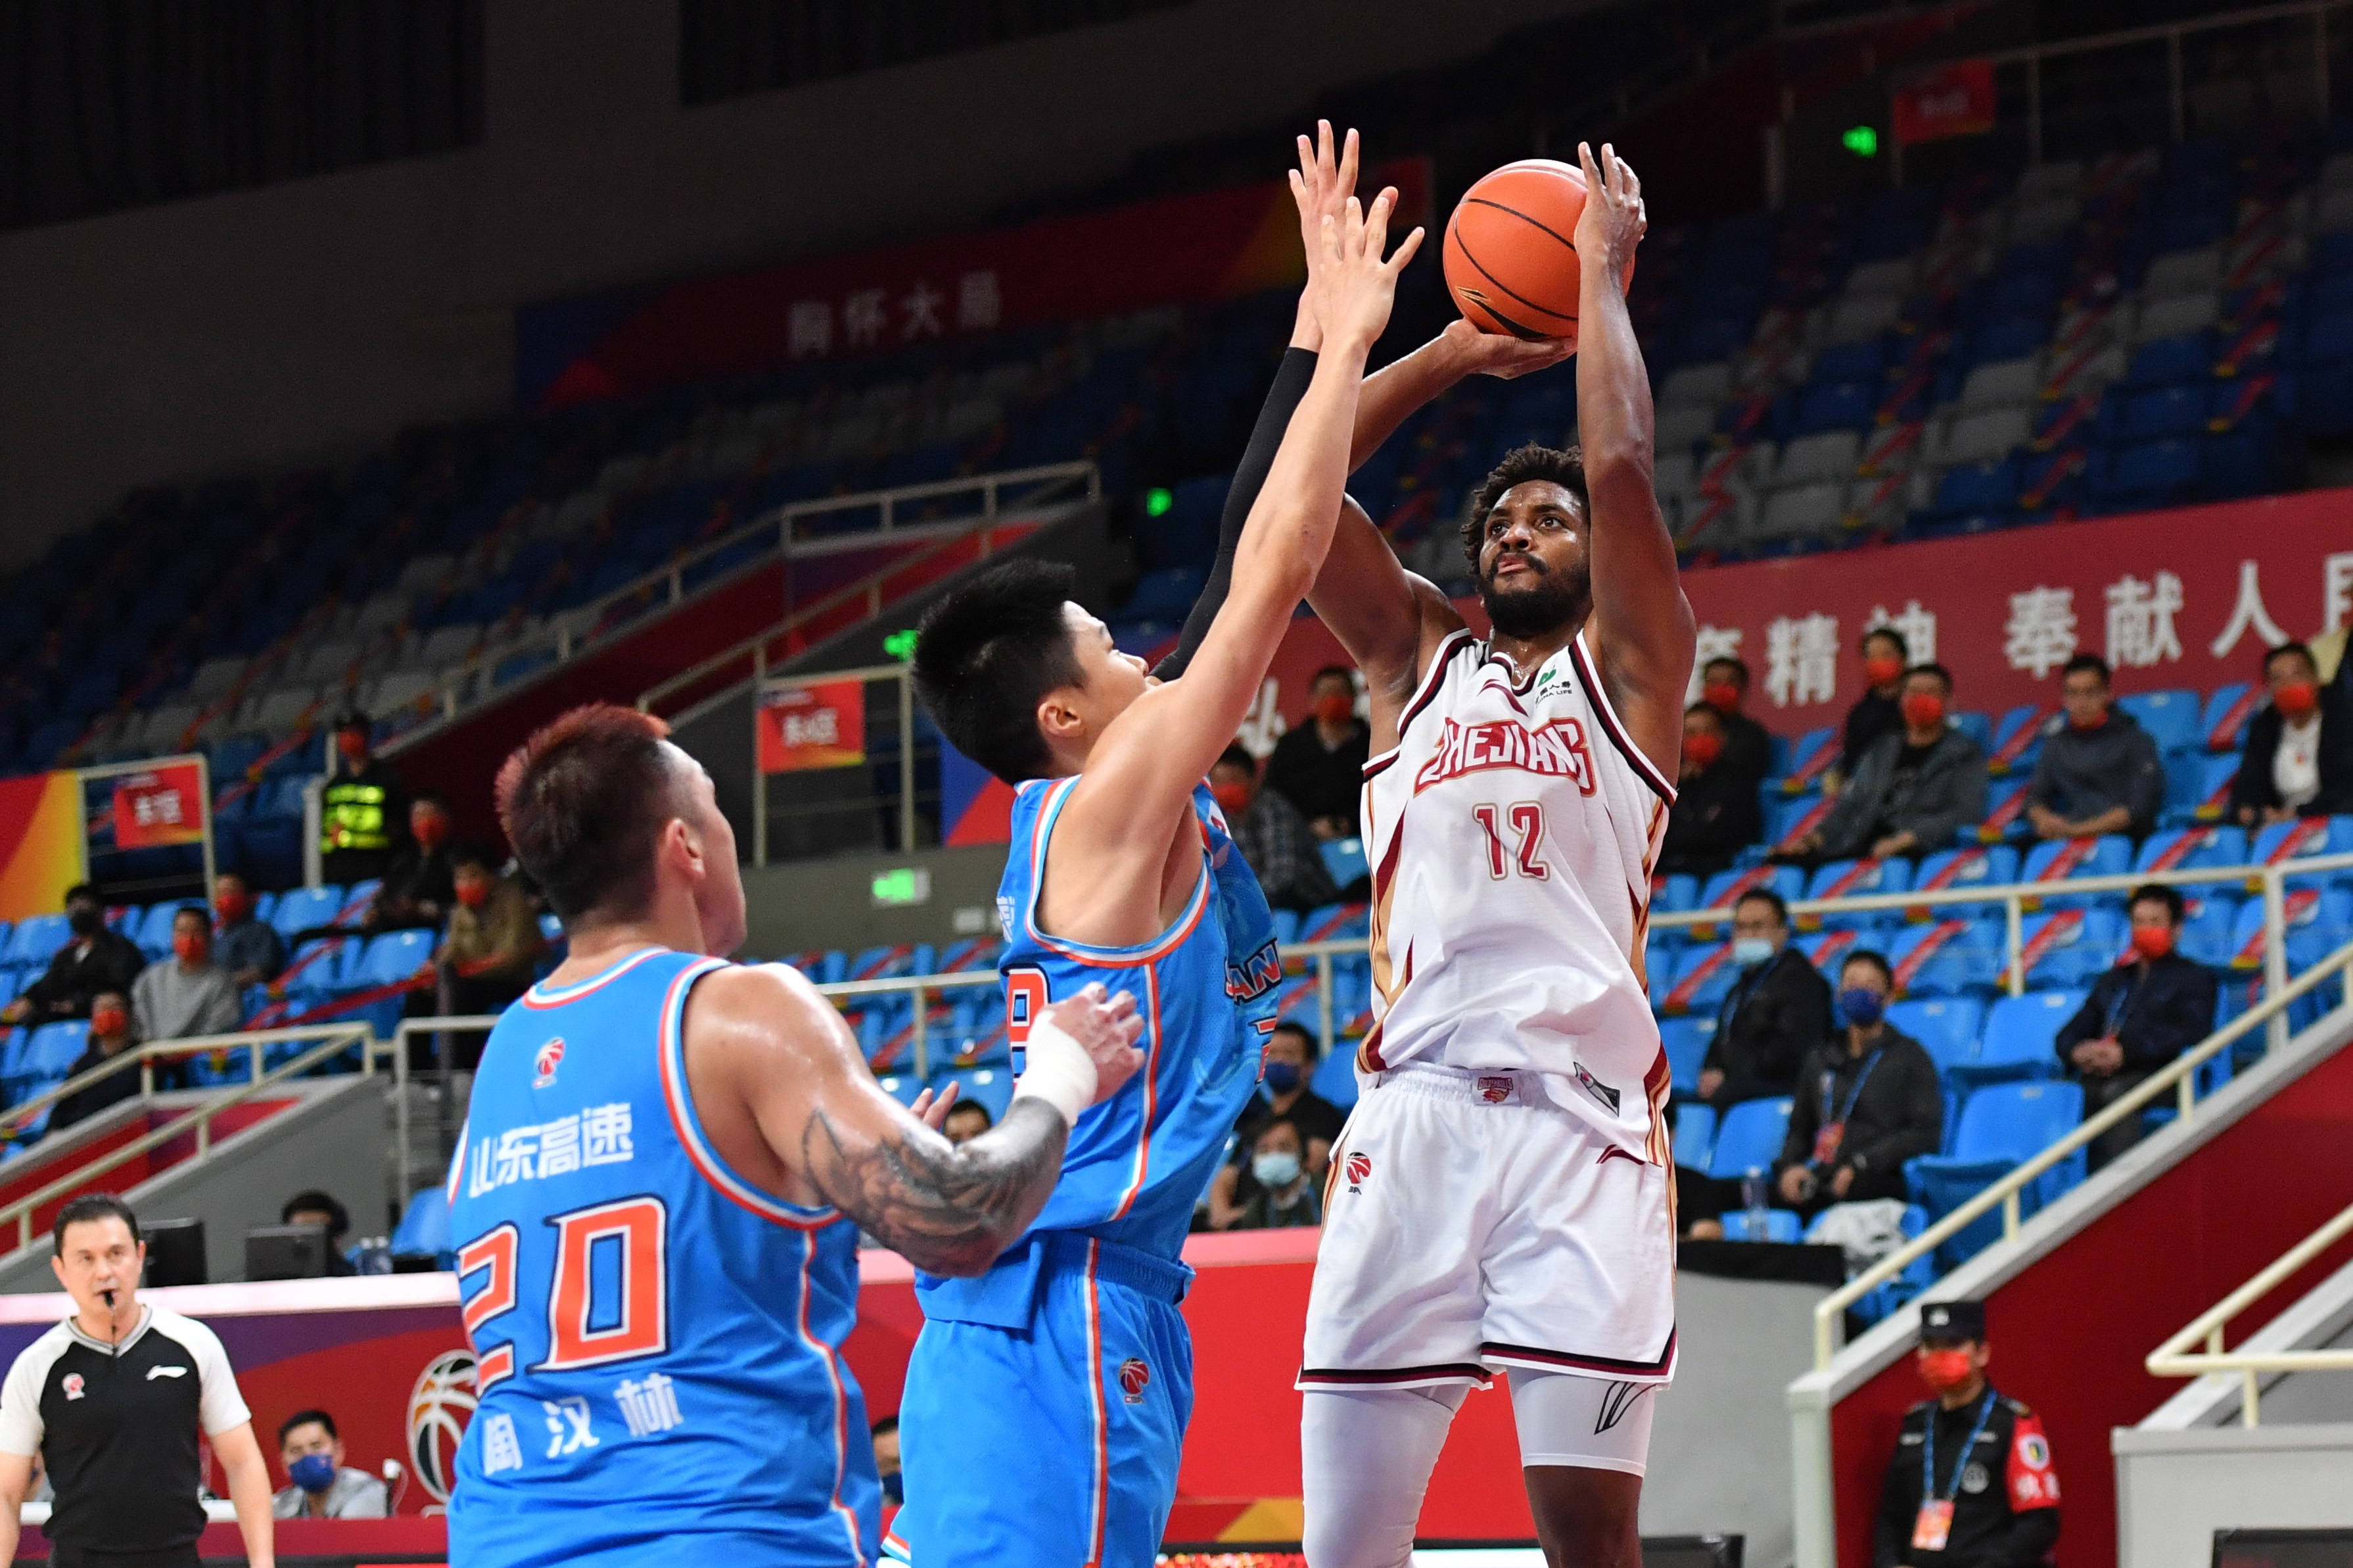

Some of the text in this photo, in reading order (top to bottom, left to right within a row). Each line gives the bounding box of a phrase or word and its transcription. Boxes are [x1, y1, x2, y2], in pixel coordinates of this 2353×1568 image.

[1473, 800, 1550, 881] 12
[469, 1102, 634, 1199] 山东高速
[457, 1220, 666, 1398] 20
